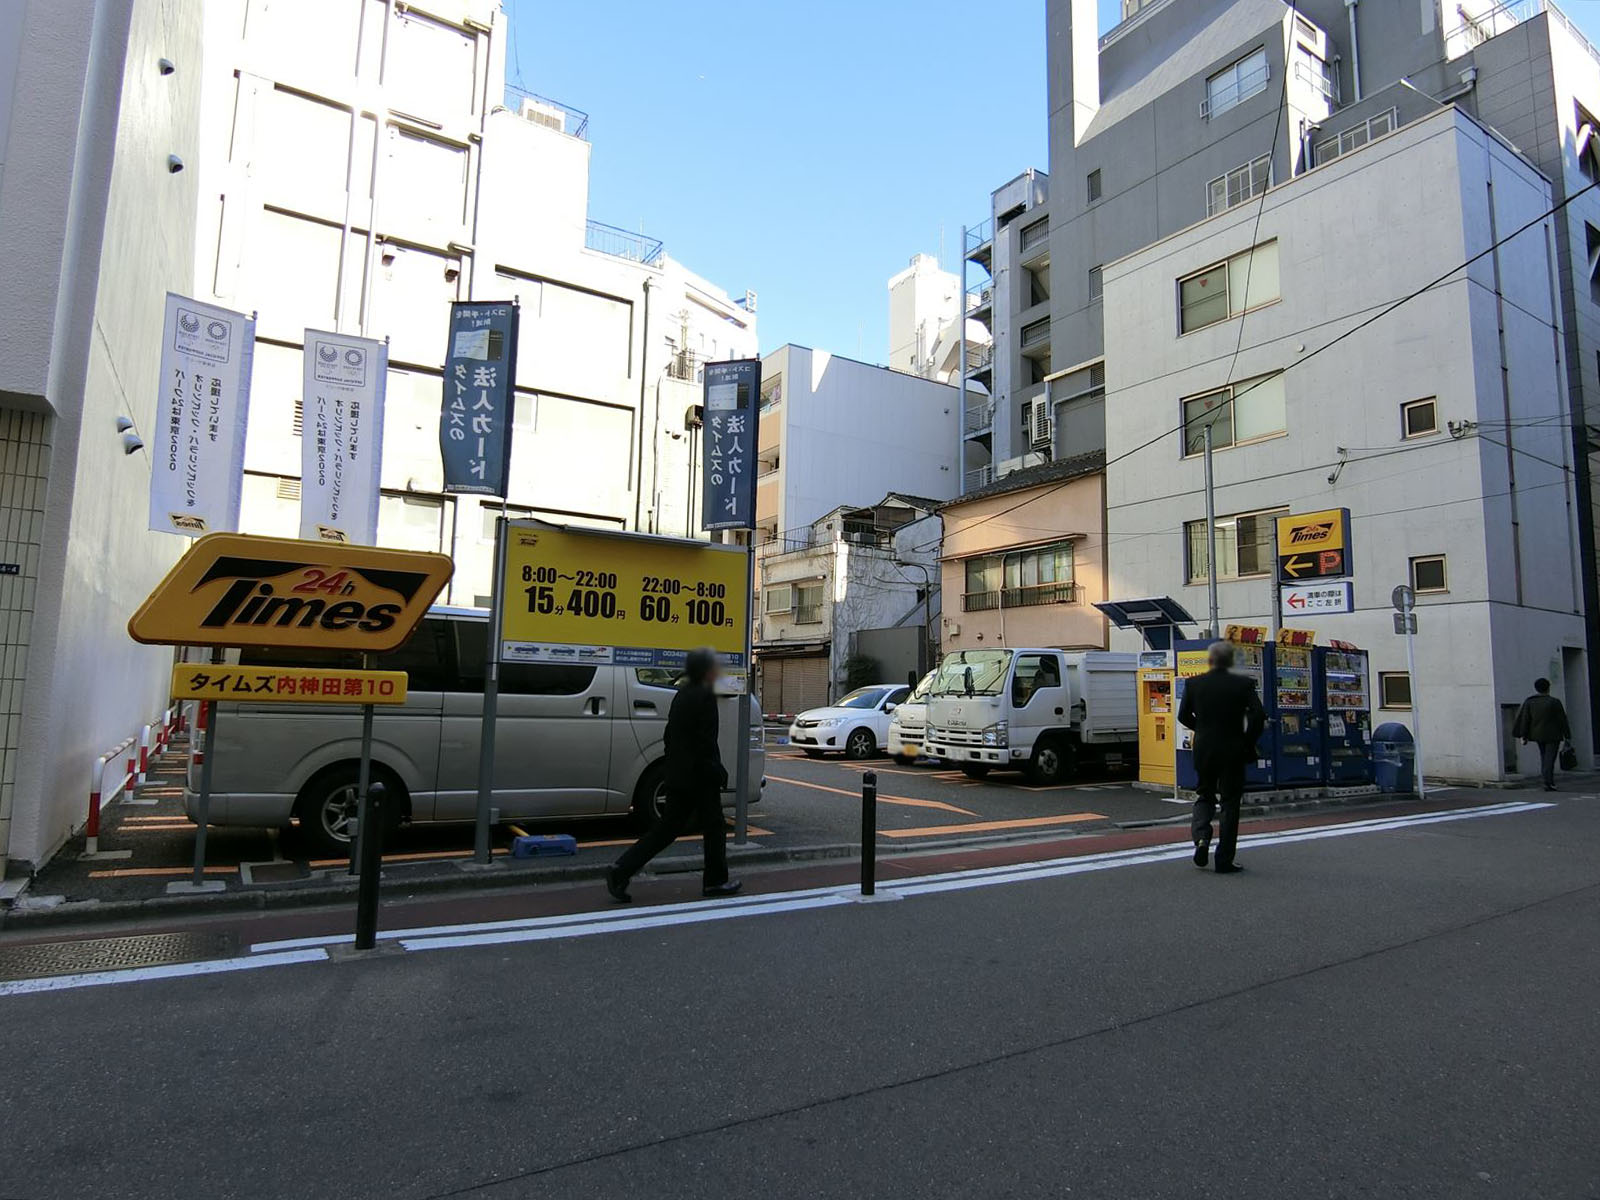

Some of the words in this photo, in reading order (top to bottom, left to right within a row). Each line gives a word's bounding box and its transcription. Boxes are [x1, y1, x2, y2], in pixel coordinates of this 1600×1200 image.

[1290, 530, 1328, 544] Times
[1319, 551, 1341, 574] P
[292, 567, 356, 596] 24h
[199, 579, 402, 632] Times
[190, 672, 394, 697] タイムズ内神田第10
